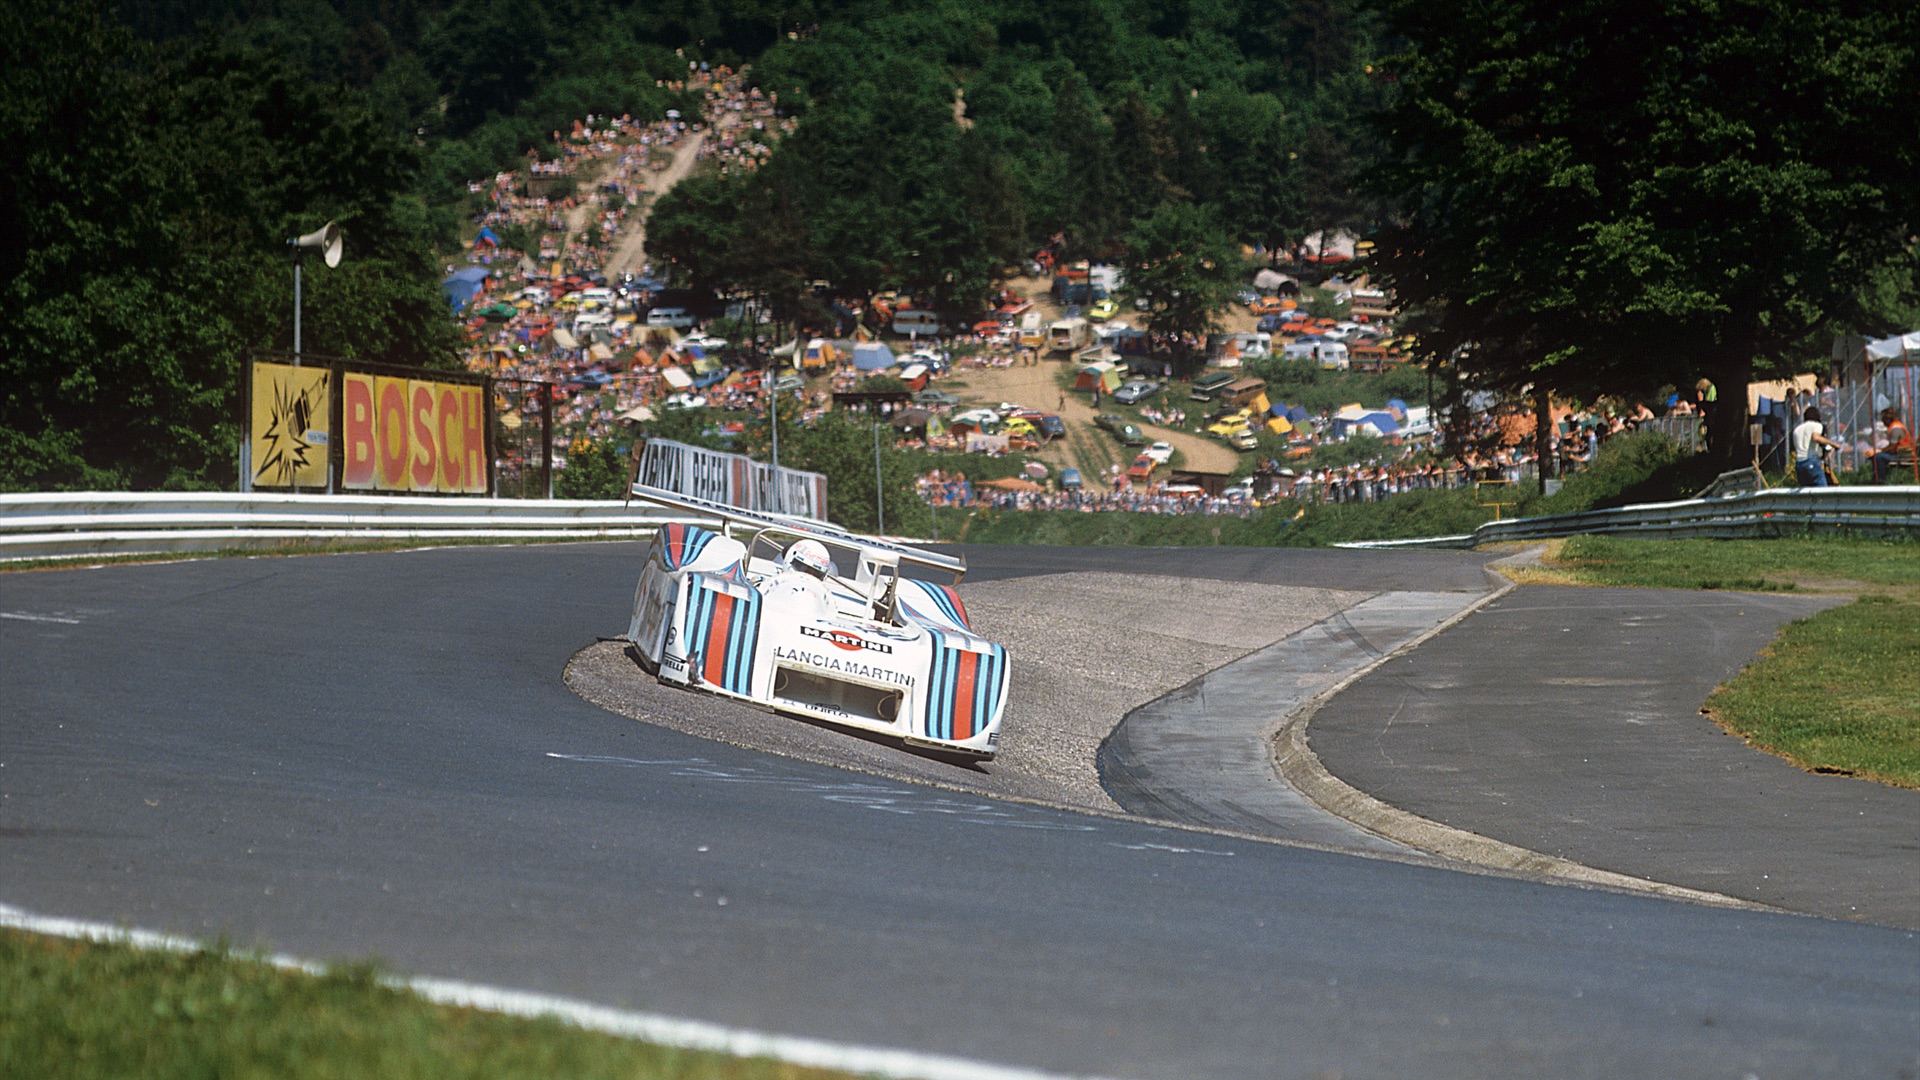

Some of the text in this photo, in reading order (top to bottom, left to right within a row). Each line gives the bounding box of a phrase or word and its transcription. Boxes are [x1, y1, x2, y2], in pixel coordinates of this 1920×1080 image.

[345, 379, 485, 488] BOSCH
[803, 627, 889, 654] MARTINI
[776, 646, 841, 670] LANCIA
